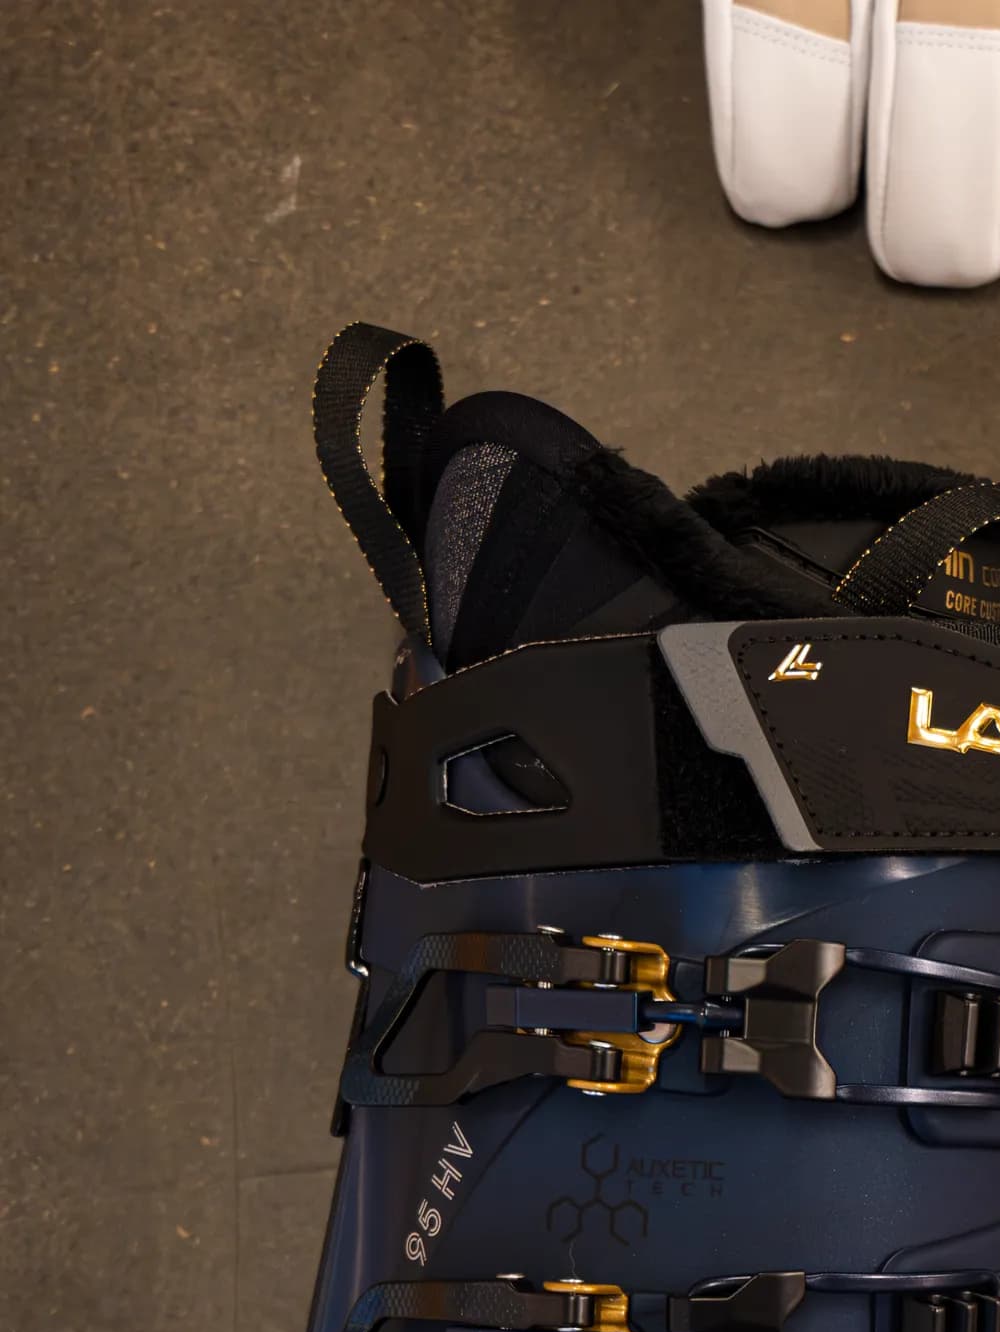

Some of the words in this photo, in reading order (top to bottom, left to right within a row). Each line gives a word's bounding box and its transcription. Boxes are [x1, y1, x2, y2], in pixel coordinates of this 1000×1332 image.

[945, 590, 977, 617] CORE
[626, 1158, 727, 1181] AUXETIC
[405, 1198, 442, 1267] 95
[431, 1121, 473, 1200] HV
[625, 1180, 722, 1197] TECH
